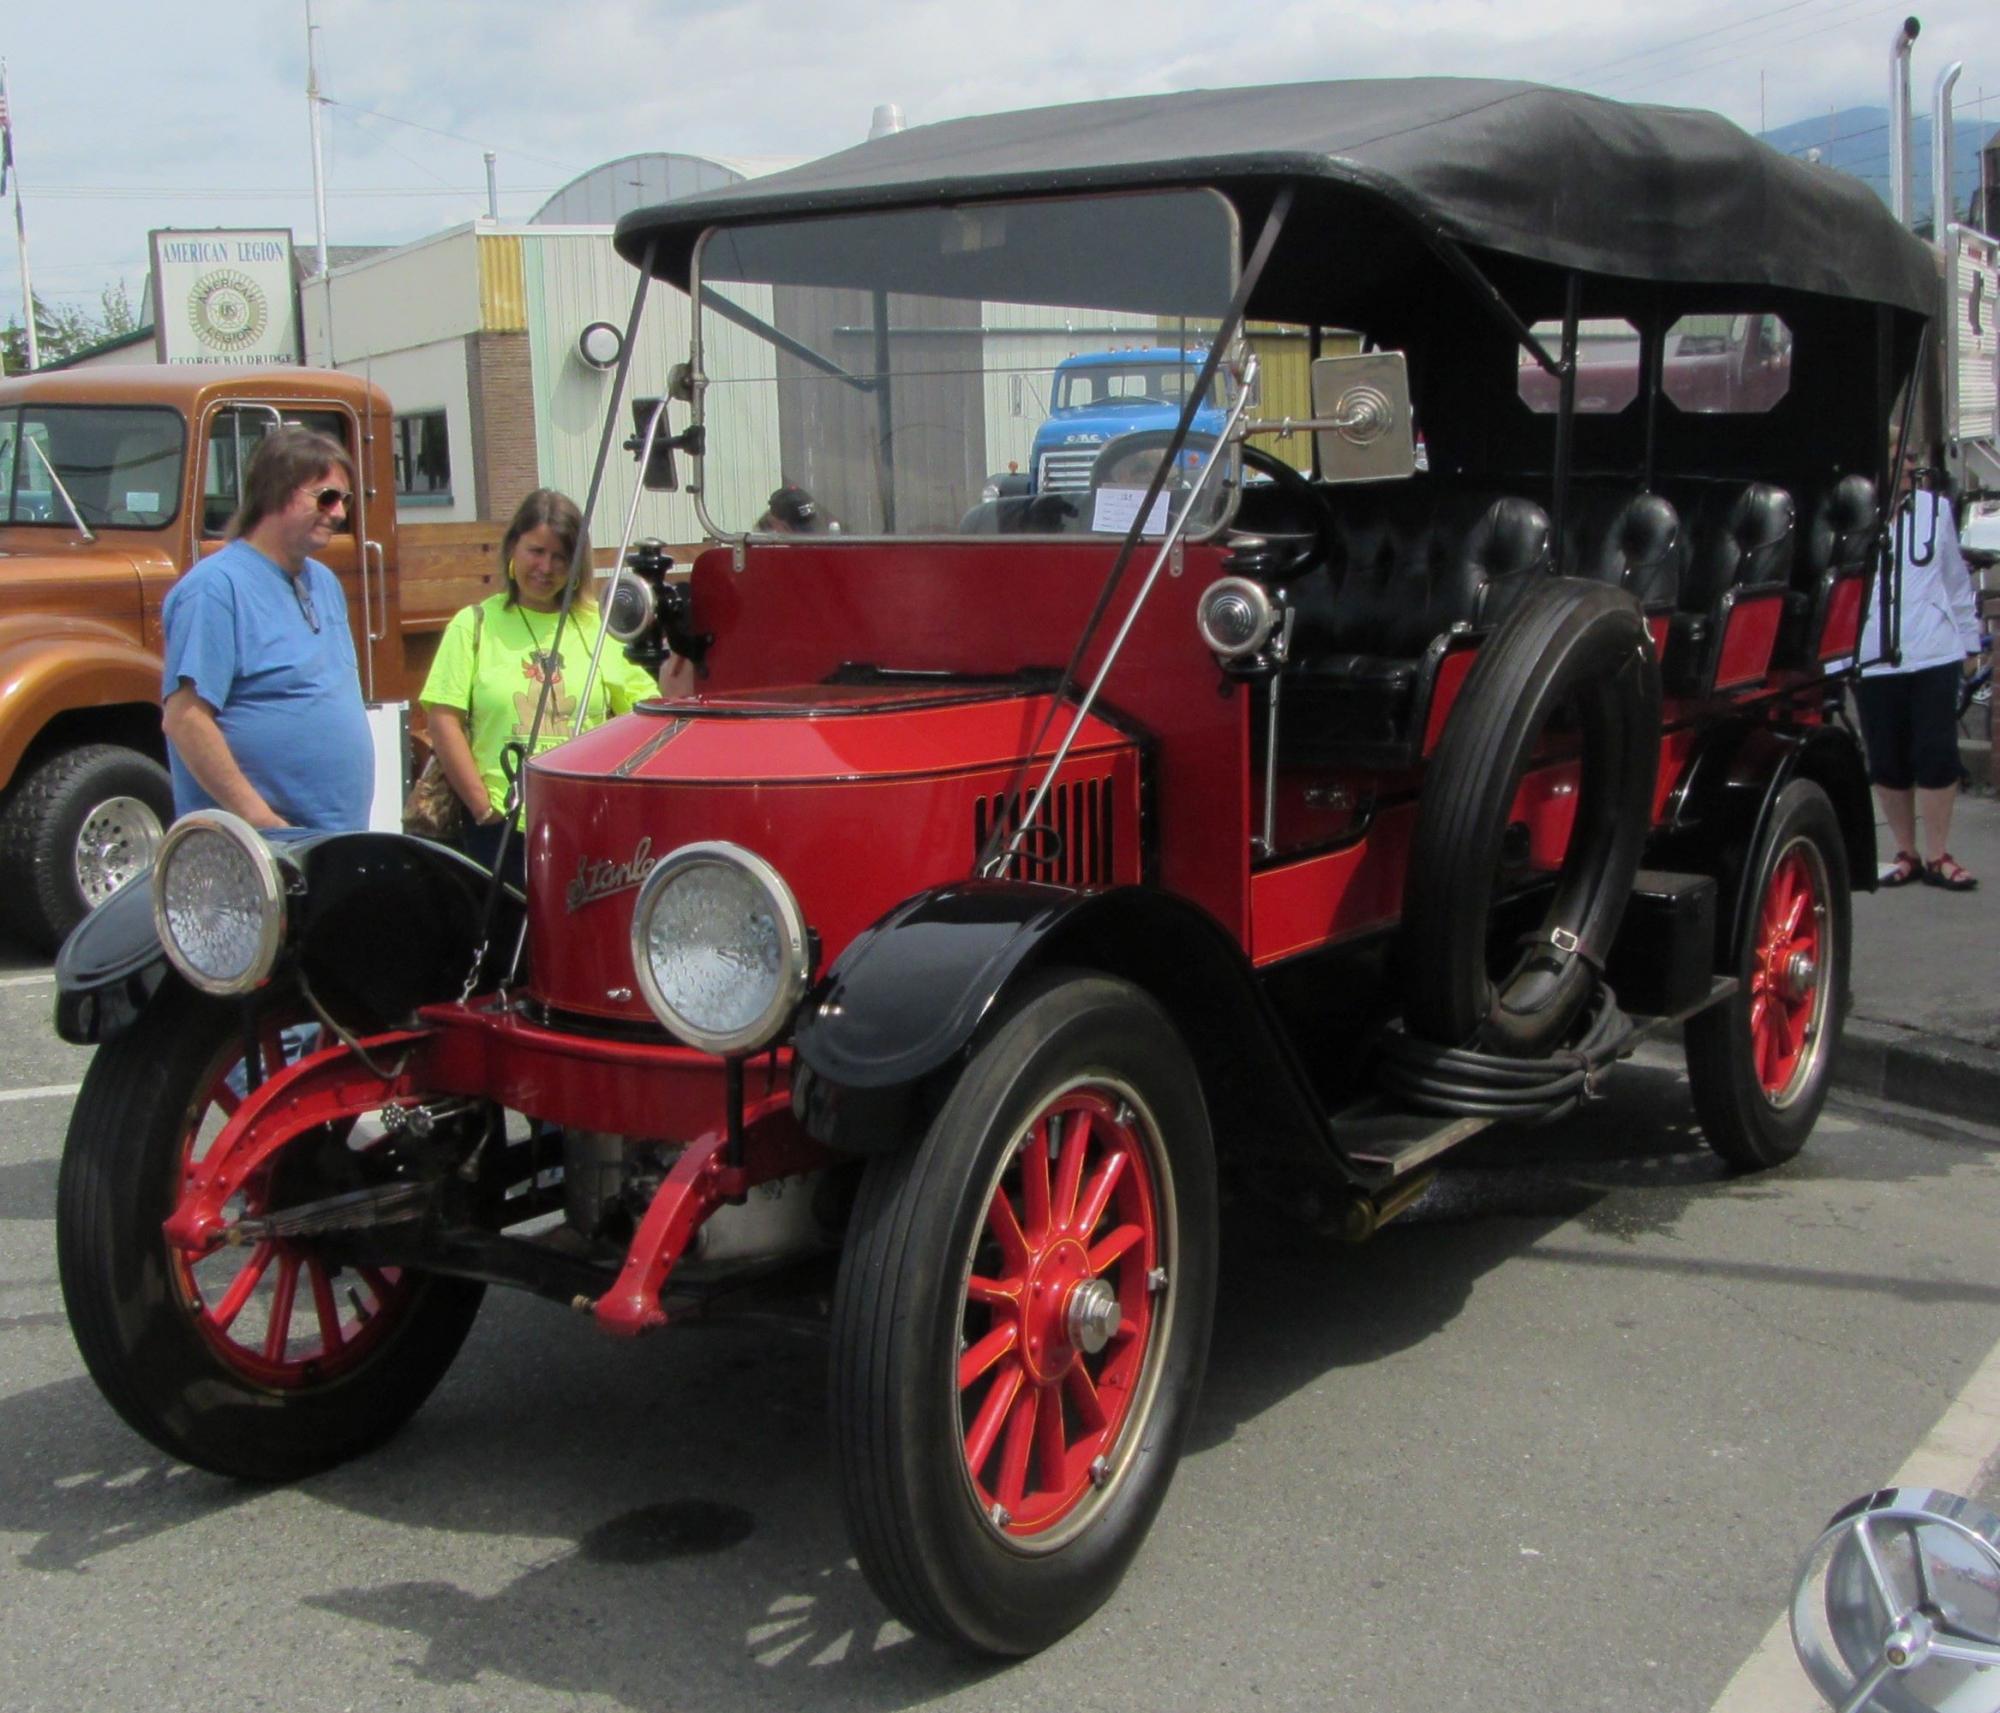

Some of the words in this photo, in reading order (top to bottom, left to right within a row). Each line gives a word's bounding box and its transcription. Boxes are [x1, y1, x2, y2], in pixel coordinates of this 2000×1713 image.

[164, 243, 228, 263] AMERICAN
[238, 242, 283, 262] LEGION
[198, 279, 257, 304] AMERICAN
[205, 326, 253, 344] LEGION
[567, 836, 656, 912] Stanle
